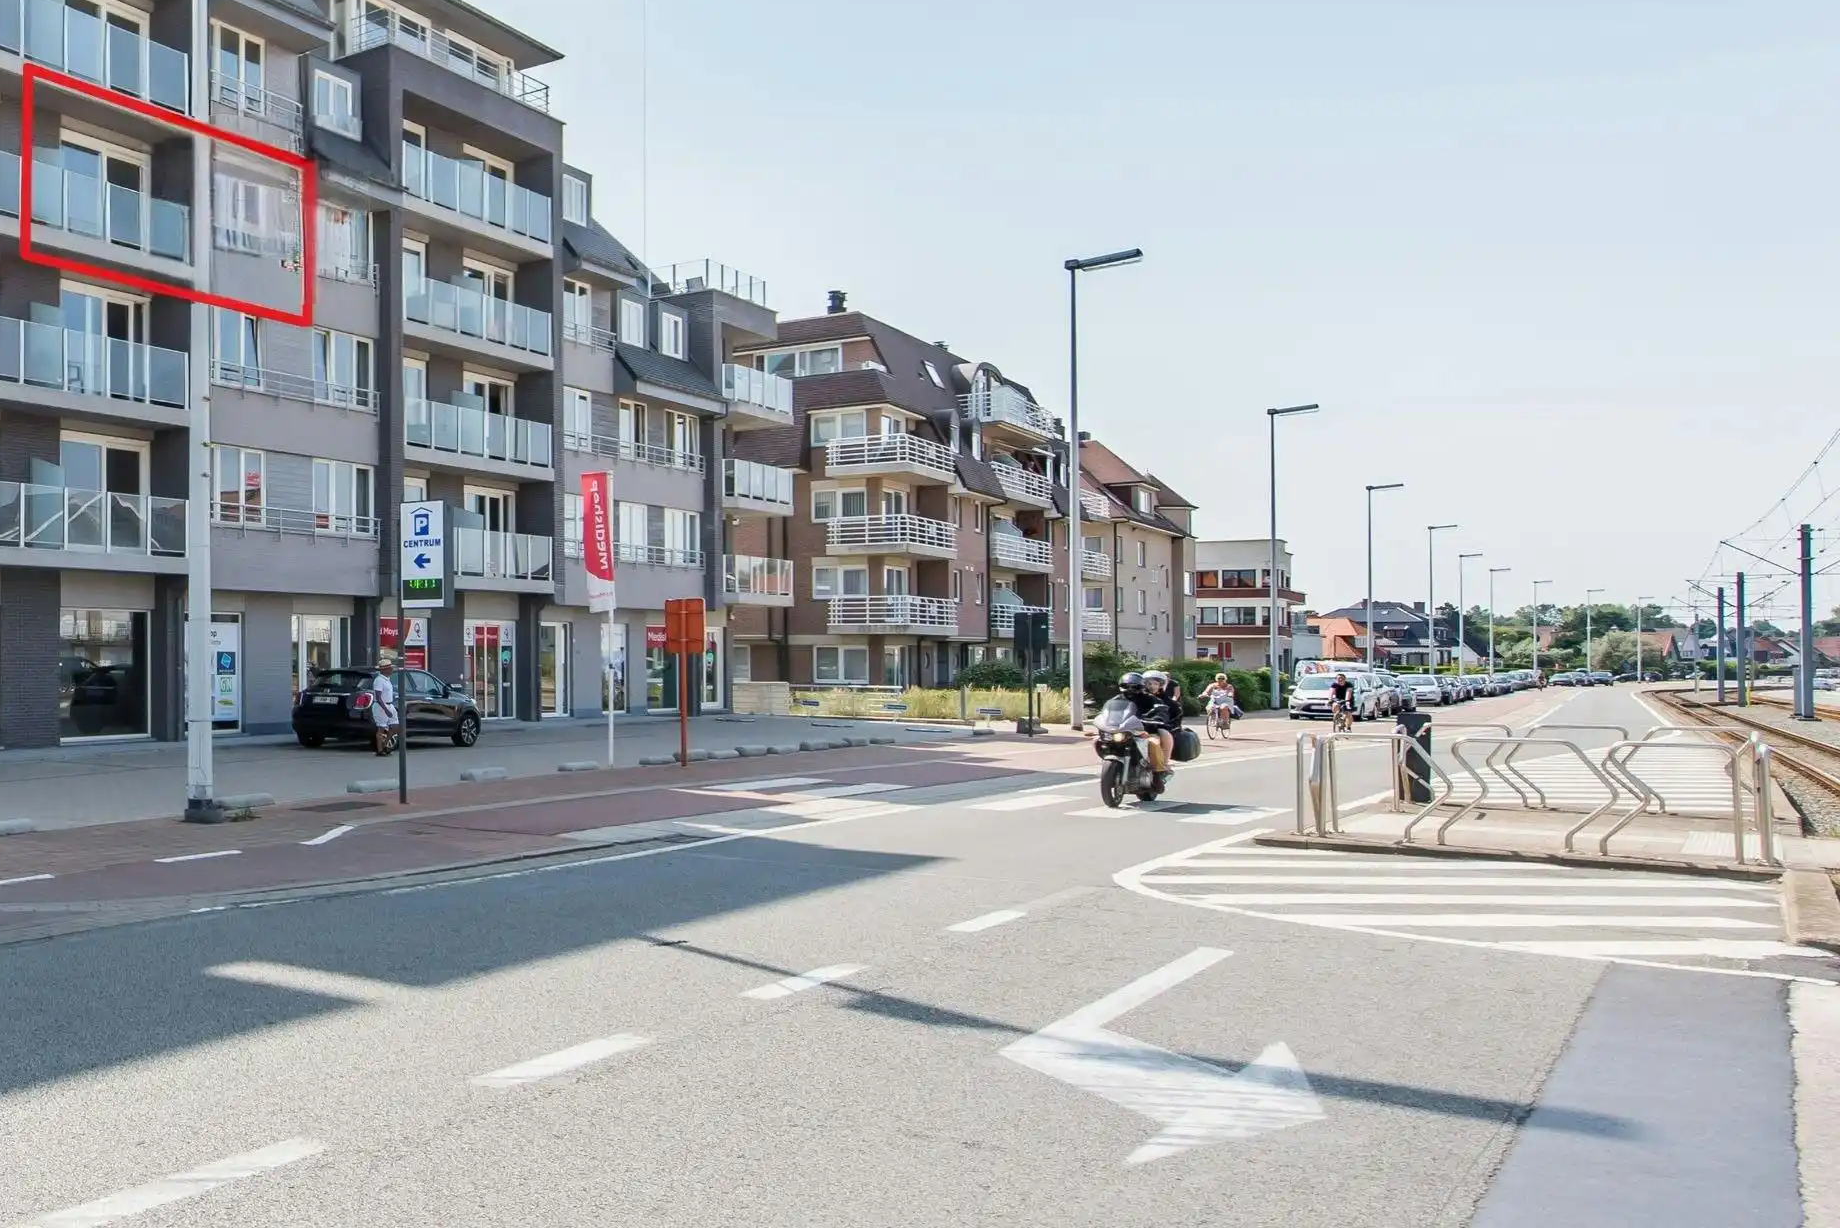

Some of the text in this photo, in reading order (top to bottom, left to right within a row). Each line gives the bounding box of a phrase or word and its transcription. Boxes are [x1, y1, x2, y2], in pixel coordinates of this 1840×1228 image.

[415, 516, 428, 533] P
[403, 538, 441, 548] CENTRUM
[647, 631, 667, 643] Medis
